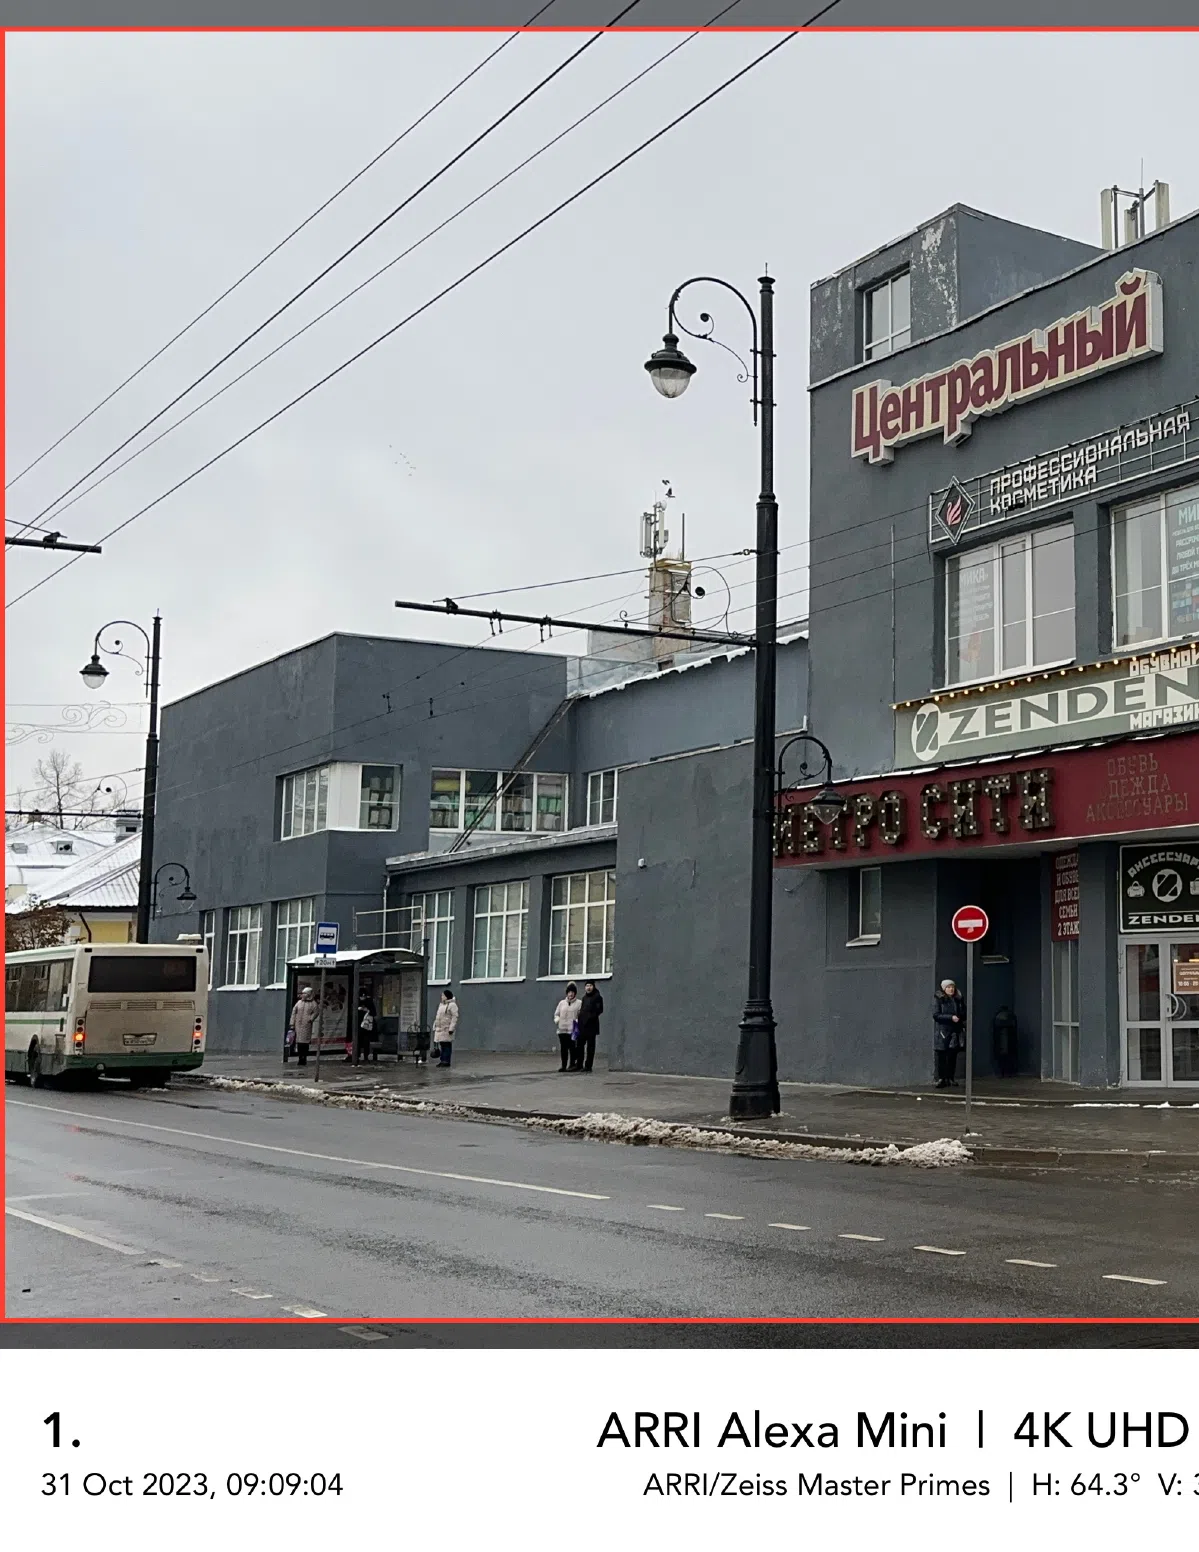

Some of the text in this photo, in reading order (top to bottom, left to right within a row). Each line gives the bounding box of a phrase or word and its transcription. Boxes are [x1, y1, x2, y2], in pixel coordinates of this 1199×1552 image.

[855, 277, 1148, 459] Центральный
[990, 411, 1190, 496] ПРОФЕССИОНАЛЬНАЯ
[990, 465, 1098, 516] КОСМЕТИКА
[1107, 753, 1159, 777] ОБУВЬ
[919, 767, 1056, 839] СИТИ
[1057, 922, 1062, 936] 2
[1058, 903, 1078, 919] СЕМЬИ
